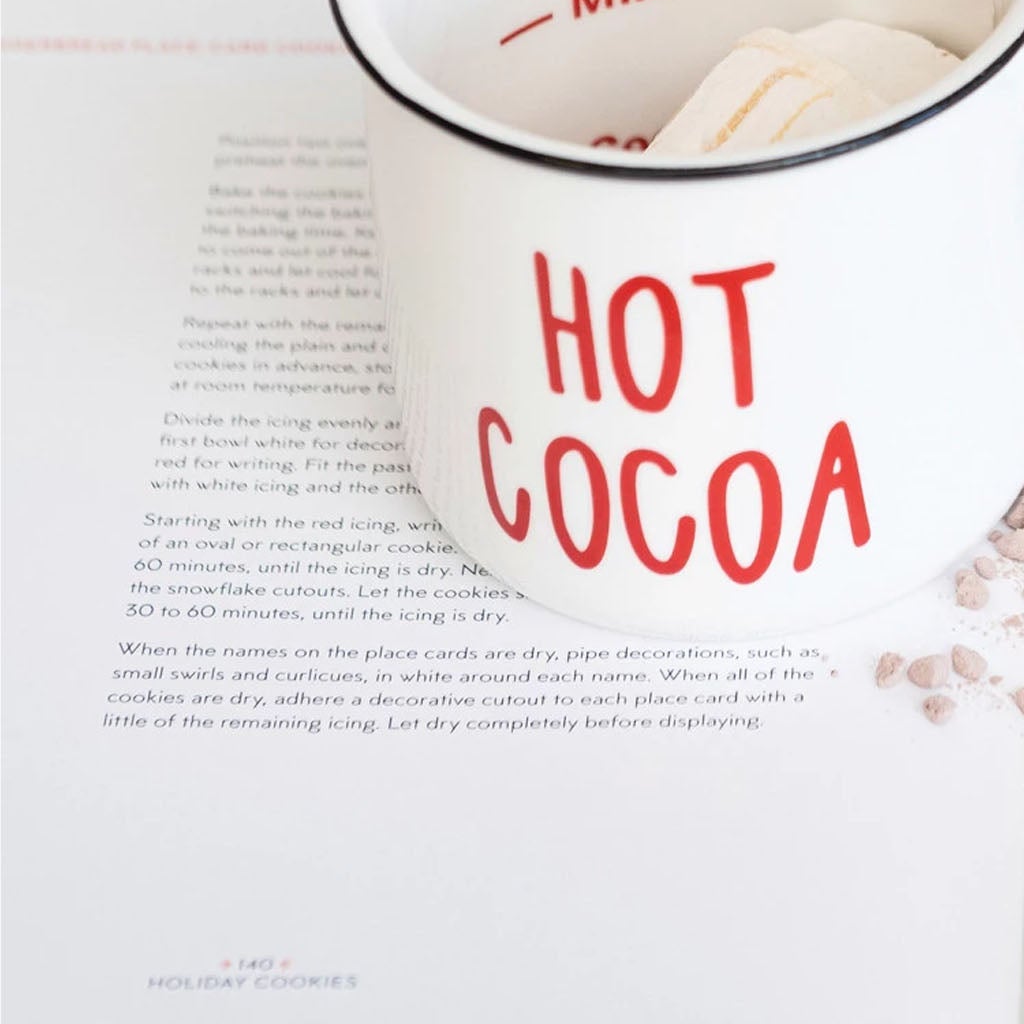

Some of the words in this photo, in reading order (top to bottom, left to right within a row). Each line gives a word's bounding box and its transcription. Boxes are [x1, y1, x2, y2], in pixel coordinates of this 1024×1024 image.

[533, 251, 776, 414] HOT
[478, 407, 871, 586] COCOA
[144, 512, 221, 532] Starting
[228, 514, 268, 529] with
[274, 515, 306, 530] the
[311, 516, 345, 531] red
[350, 516, 401, 536] icing,
[138, 534, 162, 550] of
[167, 540, 189, 551] an
[195, 537, 236, 551] oval
[241, 541, 263, 552] or
[268, 539, 383, 557] rectangular
[387, 541, 459, 555] cookie.
[133, 557, 163, 572] 60
[169, 559, 252, 575] minutes,
[256, 560, 301, 576] until
[306, 560, 339, 576] the
[343, 561, 392, 581] icing
[396, 561, 412, 577] is
[416, 562, 454, 581] dry.
[461, 562, 493, 577] Ne
[130, 580, 162, 595] the
[166, 581, 267, 598] snowflake
[271, 583, 351, 599] cutouts.
[357, 583, 390, 599] Let
[397, 584, 427, 599] the
[433, 586, 510, 599] cookies
[125, 602, 155, 618] 30
[160, 606, 181, 618] to
[187, 603, 217, 619] 60
[221, 605, 305, 622] minutes,
[312, 606, 356, 621] until
[361, 606, 393, 622] the
[400, 608, 446, 626] icing
[452, 608, 467, 620] is
[472, 607, 510, 626] dry.
[118, 641, 178, 657] When
[185, 642, 217, 658] the
[222, 647, 288, 660] names
[293, 648, 320, 659] on
[327, 644, 360, 660] the
[364, 645, 419, 664] place
[423, 645, 478, 661] cards
[484, 649, 517, 661] are
[522, 646, 560, 664] dry,
[566, 646, 610, 664] pipe
[615, 645, 740, 661] decorations,
[747, 644, 793, 659] such
[799, 648, 820, 658] as
[112, 665, 165, 681] small
[169, 666, 225, 681] swirls
[231, 666, 272, 682] and
[274, 667, 369, 685] curlicues,
[375, 668, 393, 685] in
[399, 668, 453, 687] white
[458, 668, 532, 685] around
[536, 668, 584, 683] each
[591, 671, 651, 684] name.
[658, 668, 719, 682] When
[725, 667, 749, 681] all
[754, 666, 777, 682] of
[783, 666, 815, 681] the
[106, 687, 185, 705] cookies
[191, 694, 225, 706] are
[230, 691, 271, 710] dry,
[273, 690, 345, 707] adhere
[350, 695, 363, 707] a
[368, 689, 477, 709] decorative
[482, 693, 549, 708] cutout
[552, 693, 575, 708] to
[580, 691, 628, 706] each
[634, 691, 689, 710] place
[693, 690, 739, 705] card
[745, 689, 787, 704] with
[793, 693, 805, 703] a
[102, 712, 148, 728] little
[153, 713, 178, 728] of
[182, 713, 215, 729] the
[220, 714, 322, 735] remaining
[327, 715, 380, 735] icing.
[387, 715, 422, 731] Let
[424, 715, 462, 735] dry
[465, 712, 580, 734] completely
[584, 713, 653, 729] before
[658, 713, 764, 731] displaying.
[238, 959, 274, 971] 140
[147, 975, 247, 991] HOLIDAY
[254, 975, 358, 990] COOKIES
